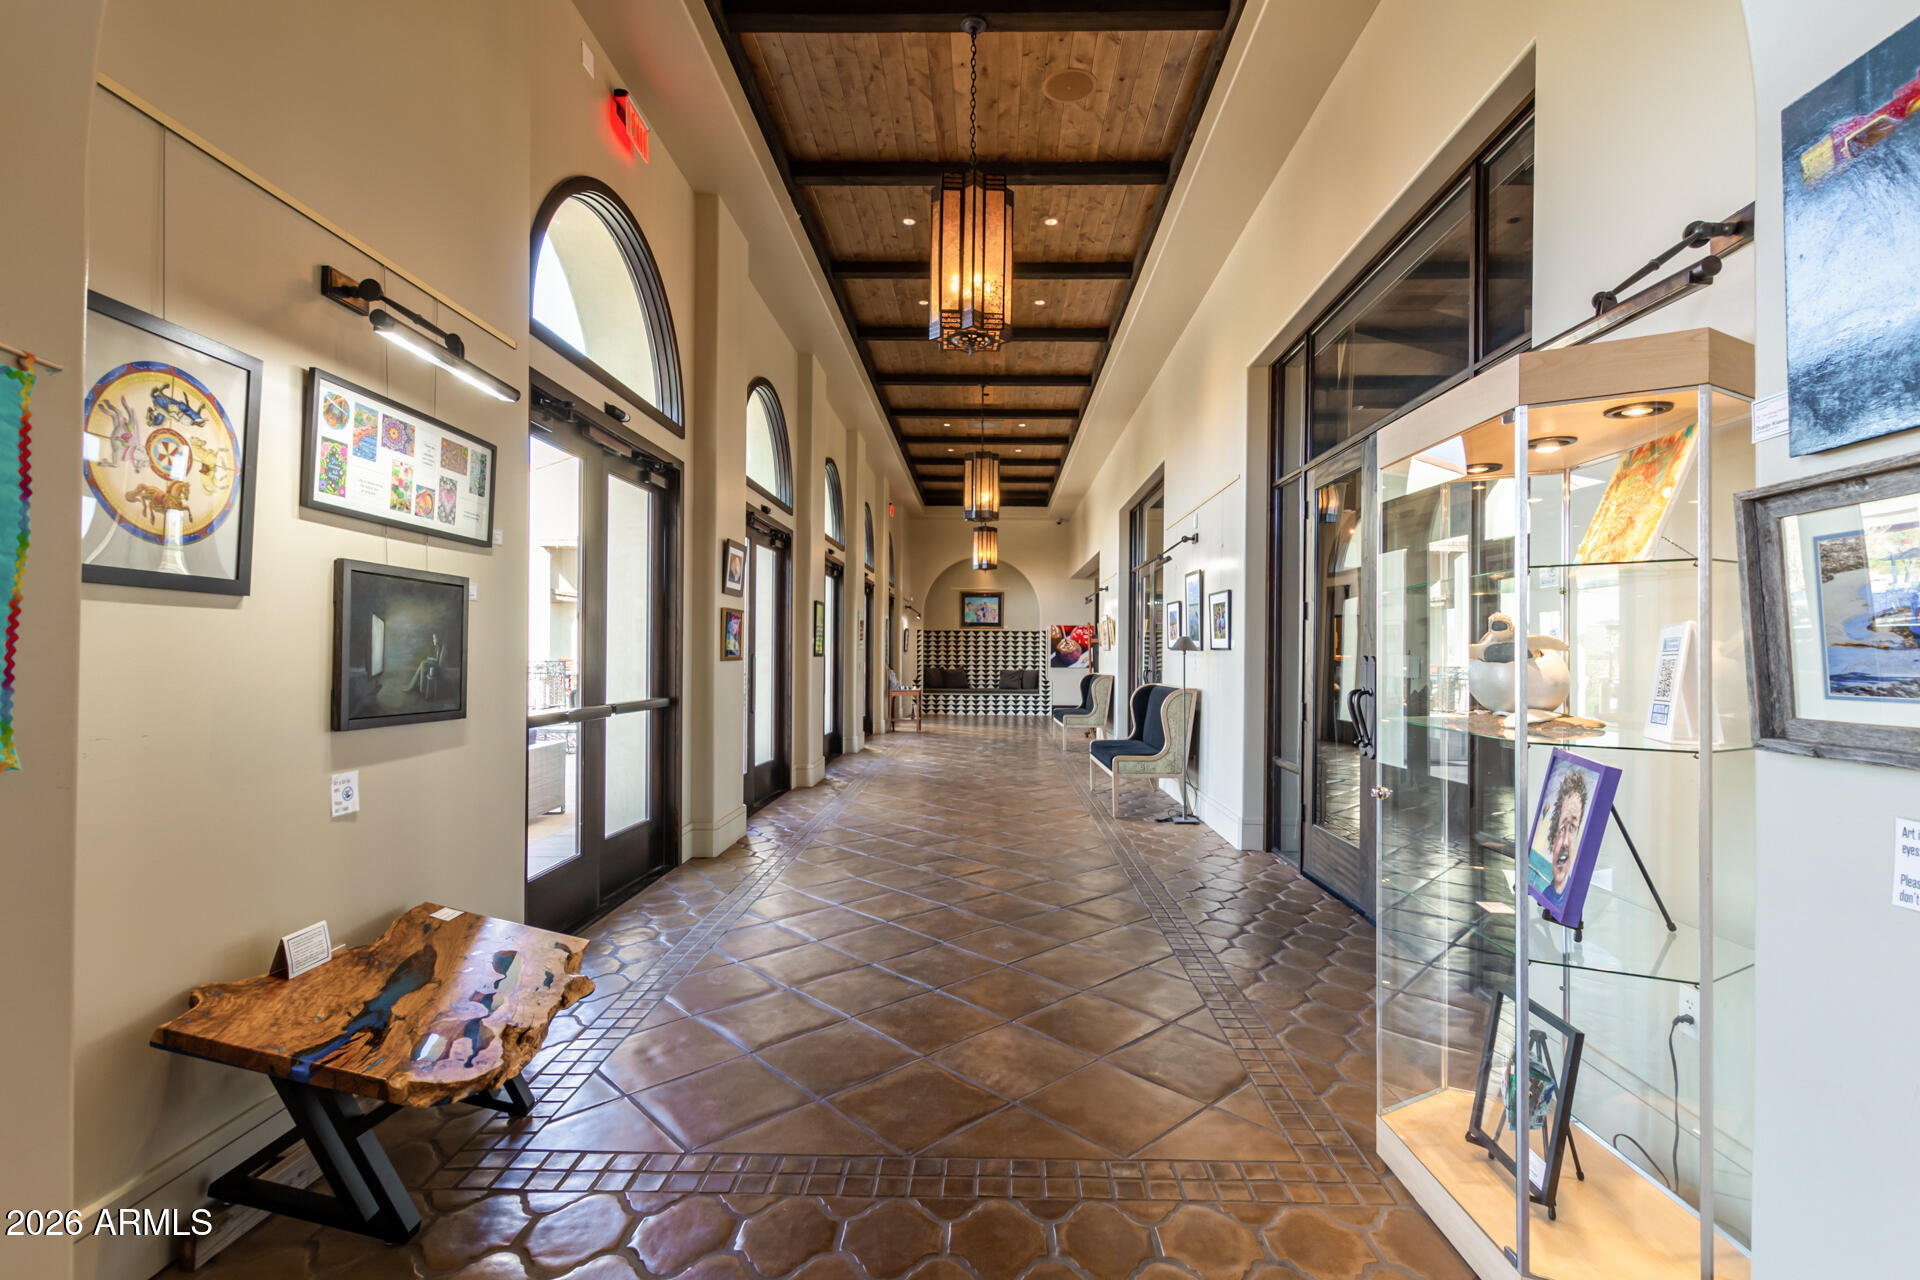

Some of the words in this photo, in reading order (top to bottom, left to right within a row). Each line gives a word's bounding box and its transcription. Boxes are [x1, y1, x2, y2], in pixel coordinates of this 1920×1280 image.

[1902, 826, 1915, 841] Art
[1900, 873, 1920, 890] Pleas
[1899, 889, 1920, 906] don't
